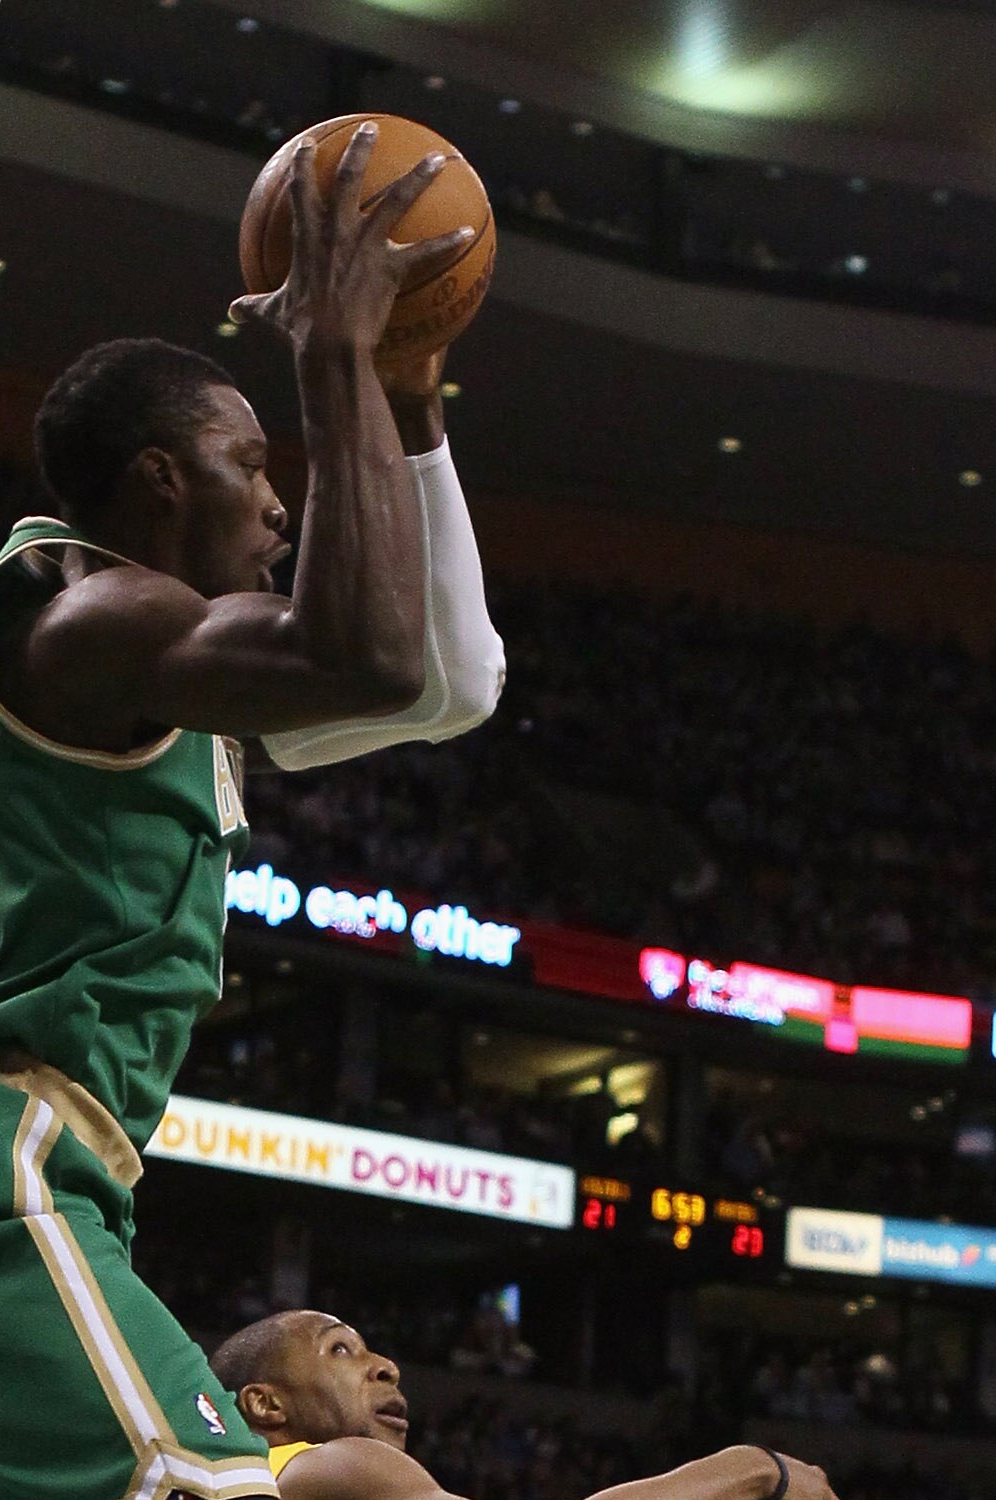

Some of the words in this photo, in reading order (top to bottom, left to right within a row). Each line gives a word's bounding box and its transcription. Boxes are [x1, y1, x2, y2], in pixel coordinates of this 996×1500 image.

[305, 886, 407, 938] each
[410, 904, 521, 967] other
[351, 1148, 515, 1209] DONUTS
